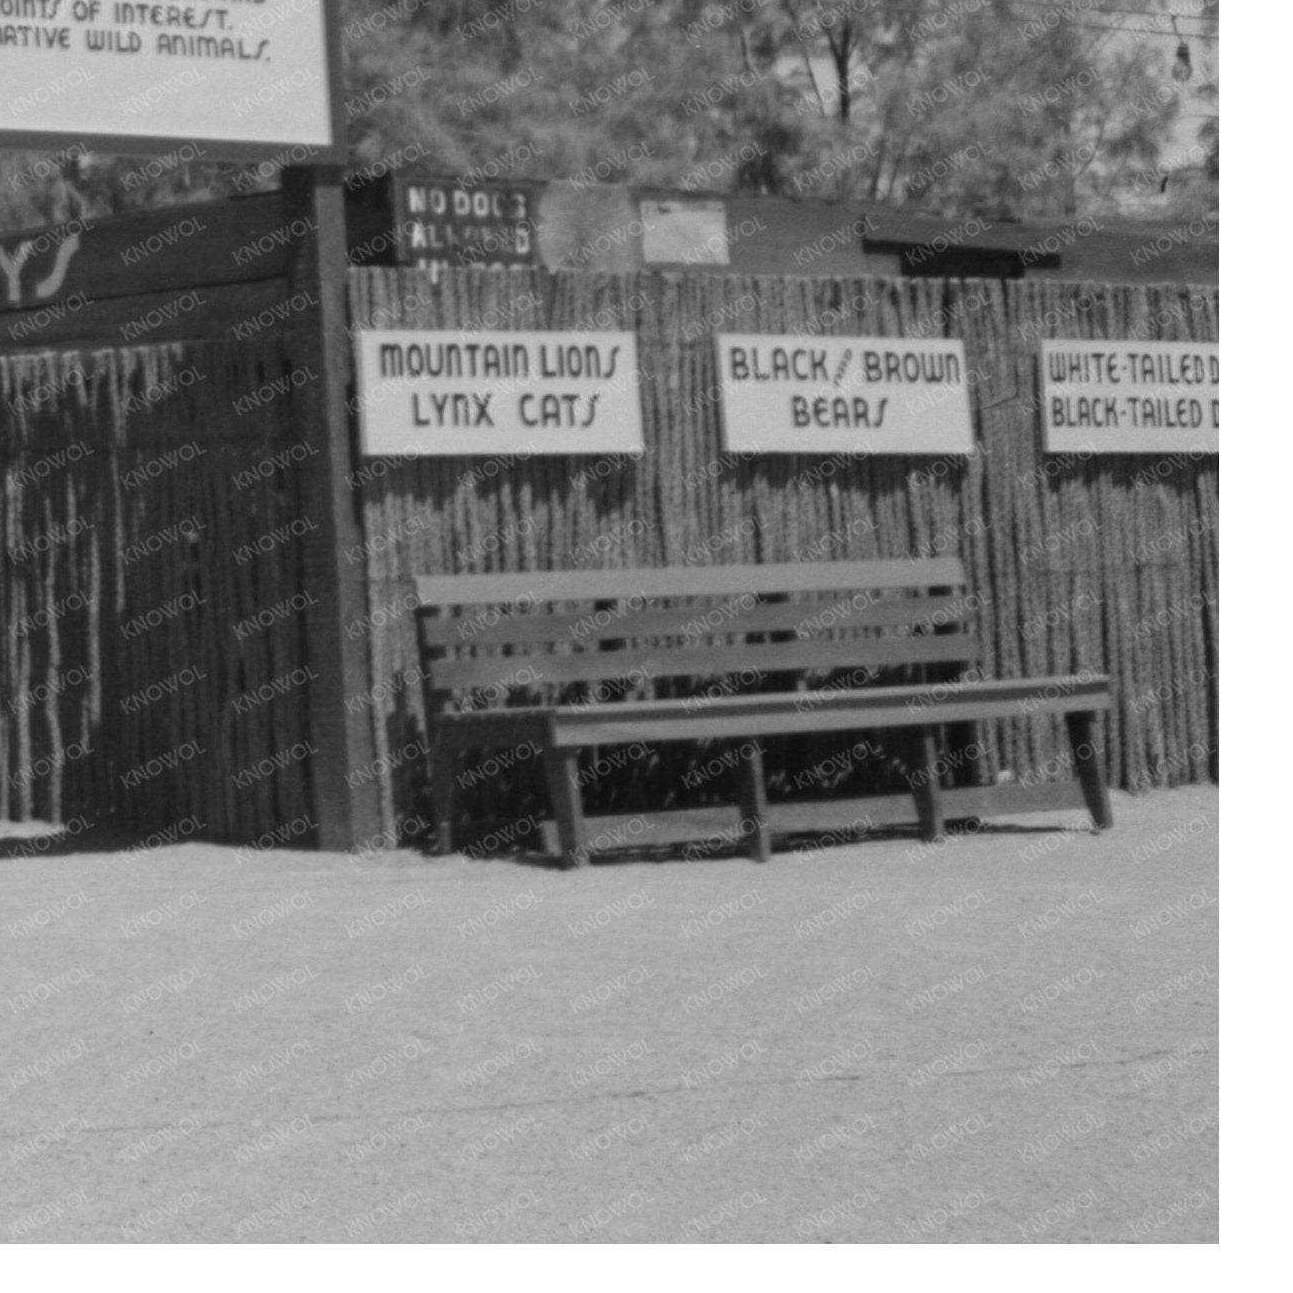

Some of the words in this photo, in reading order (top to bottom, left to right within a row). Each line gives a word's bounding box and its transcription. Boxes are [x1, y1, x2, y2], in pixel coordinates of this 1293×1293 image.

[71, 0, 101, 23] OF
[113, 1, 233, 31] INTEREST.
[84, 28, 143, 55] WILD
[378, 342, 530, 379] MOUNTAIN
[538, 343, 621, 380] LIONS
[729, 346, 830, 382] BLACK
[862, 350, 961, 385] BROWN
[1048, 351, 1205, 386] WHITE-TAILED
[411, 392, 495, 428] LYNX
[517, 392, 600, 429] CATS
[790, 394, 889, 429] BEARS
[1050, 395, 1203, 429] BLACK-TAILED
